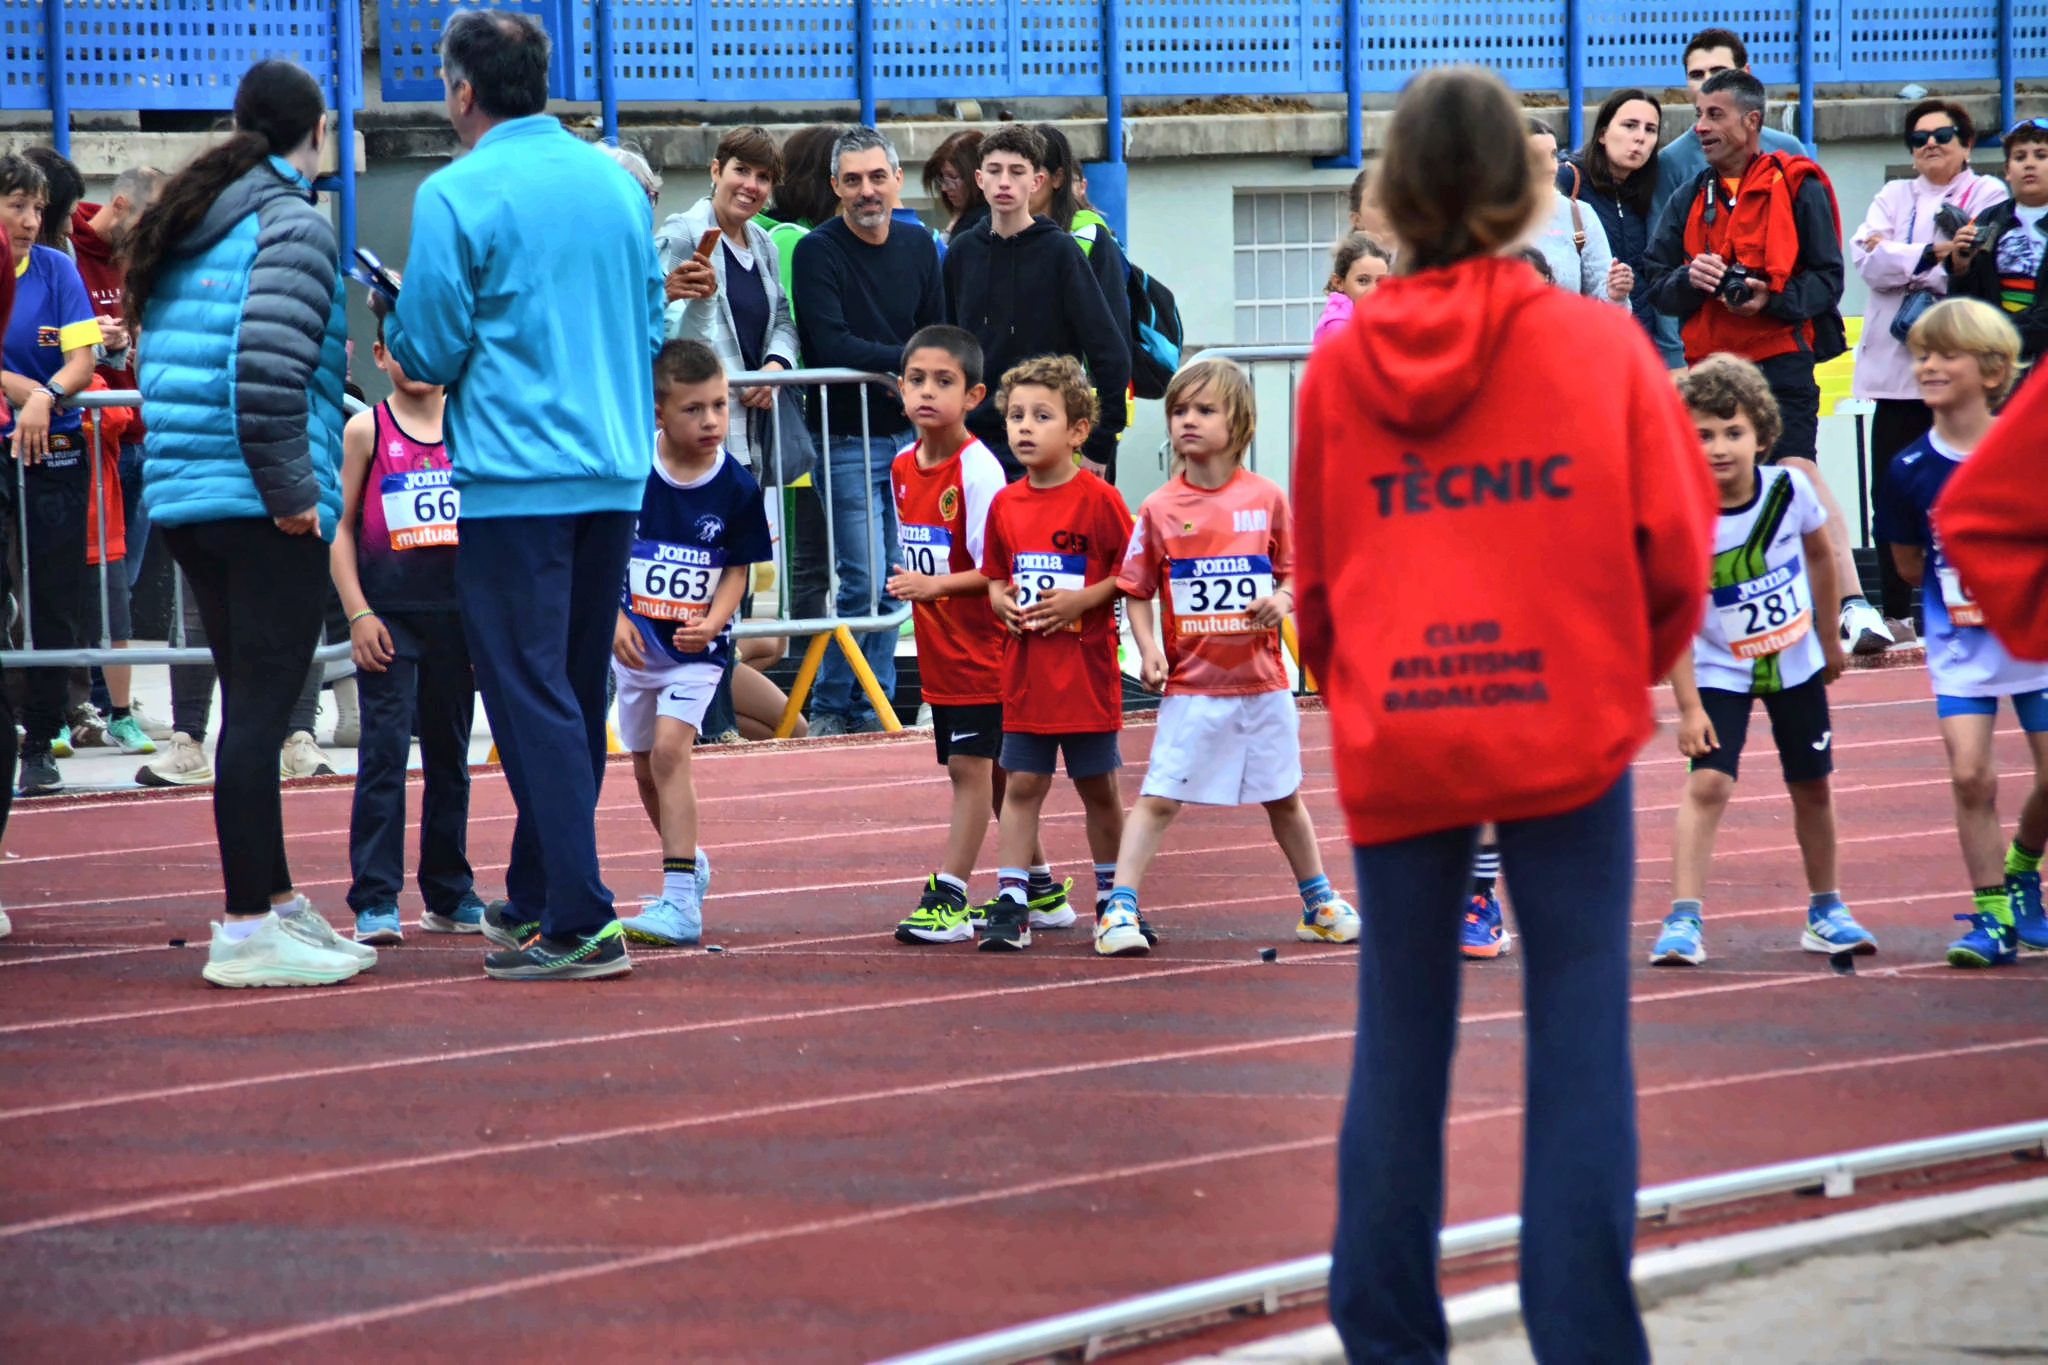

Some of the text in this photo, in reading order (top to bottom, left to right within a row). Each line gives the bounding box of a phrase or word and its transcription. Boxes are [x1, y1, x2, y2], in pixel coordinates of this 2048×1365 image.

[1370, 452, 1572, 517] TÈCNIC
[645, 564, 711, 601] 663
[1190, 577, 1257, 612] 329
[1738, 584, 1801, 635] 281
[1424, 619, 1500, 647] CLUB
[1391, 649, 1543, 680] ATLETISME
[1384, 680, 1549, 712] BADALONA
